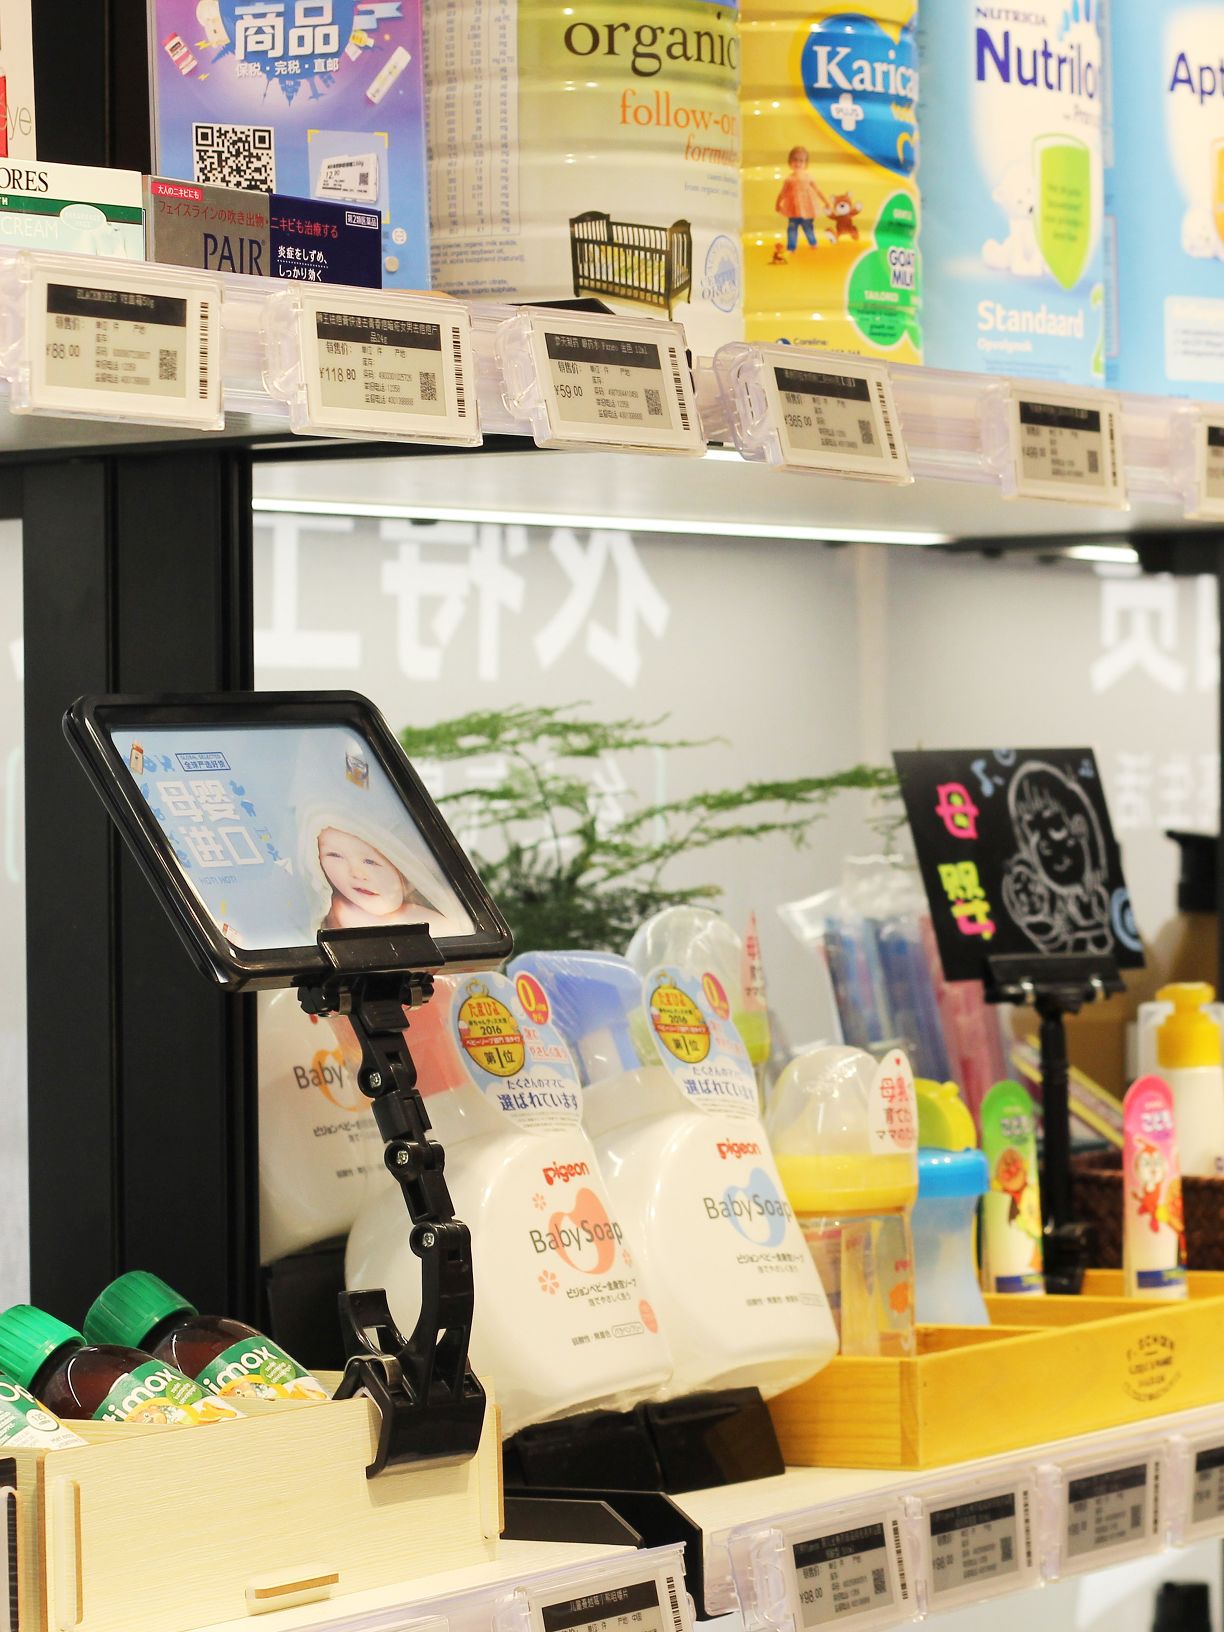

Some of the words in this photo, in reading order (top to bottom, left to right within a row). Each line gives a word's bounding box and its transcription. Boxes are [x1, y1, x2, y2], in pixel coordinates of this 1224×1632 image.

[235, 0, 339, 60] 商品
[564, 11, 737, 77] organic
[203, 232, 263, 277] PAIR
[977, 300, 1084, 339] Standaard
[319, 367, 357, 383] ¥118.80
[553, 384, 583, 399] ¥59.00
[480, 1025, 503, 1036] 2016
[497, 1091, 578, 1111] 選ばれています
[716, 1138, 761, 1160] pigeon
[542, 1161, 591, 1187] pigeon
